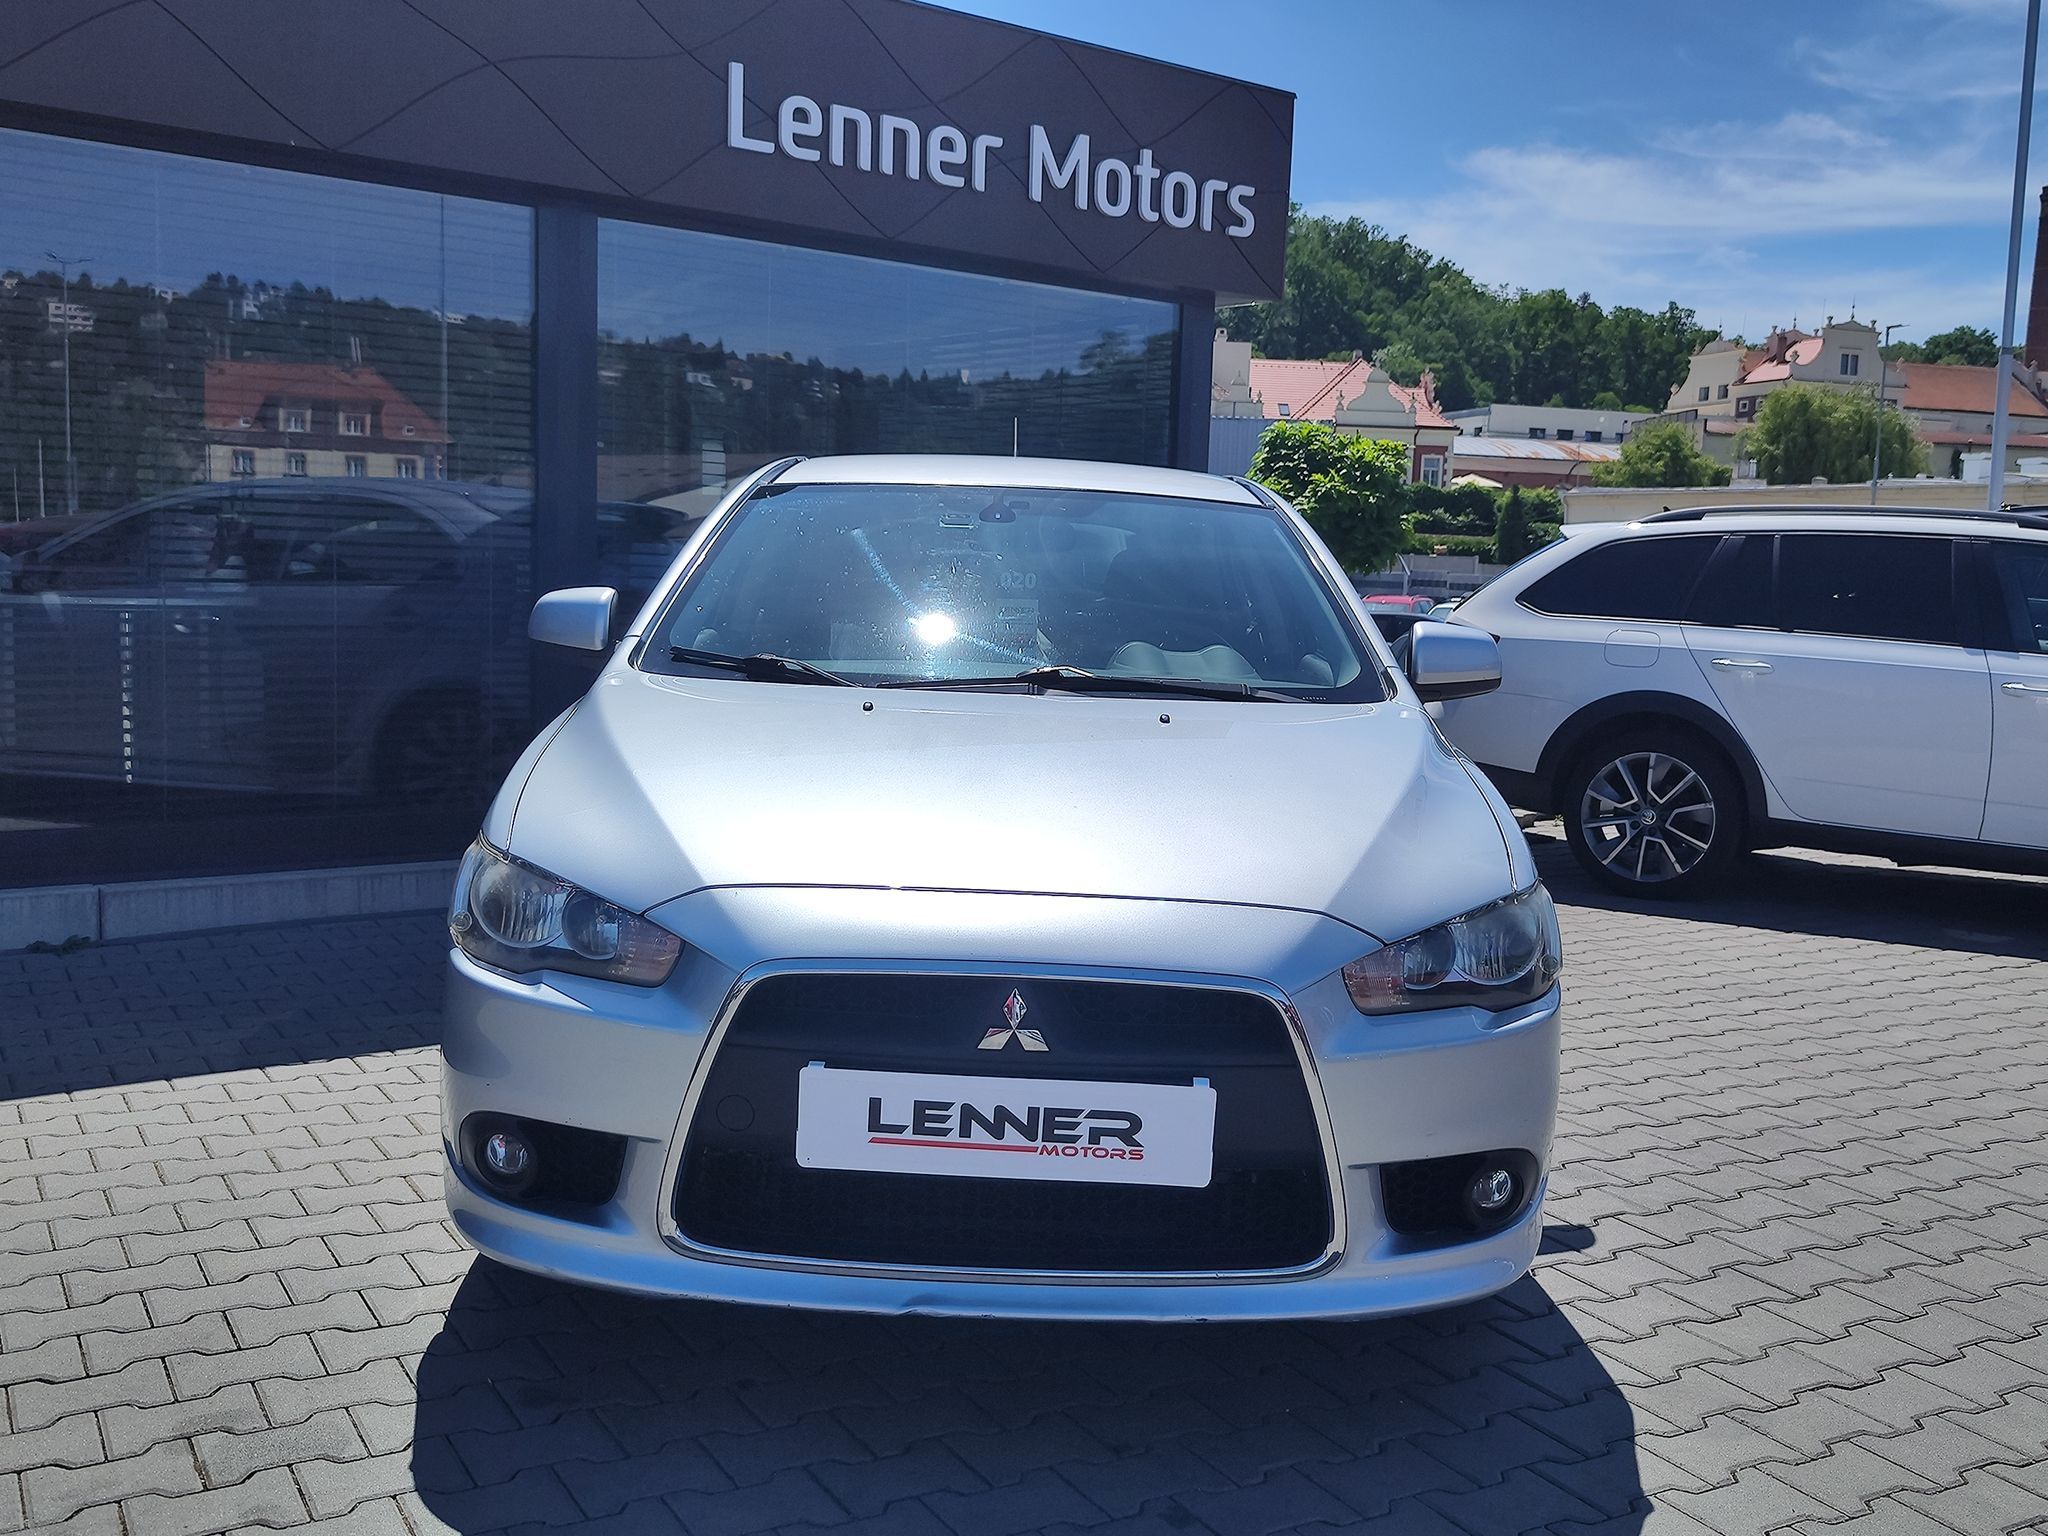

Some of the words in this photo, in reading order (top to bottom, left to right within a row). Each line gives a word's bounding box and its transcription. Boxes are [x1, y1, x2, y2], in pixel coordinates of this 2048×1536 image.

[727, 61, 1004, 192] Lenner
[1028, 124, 1257, 238] Motors
[867, 1096, 1145, 1148] LENNER
[1038, 1144, 1145, 1161] MOTORS
